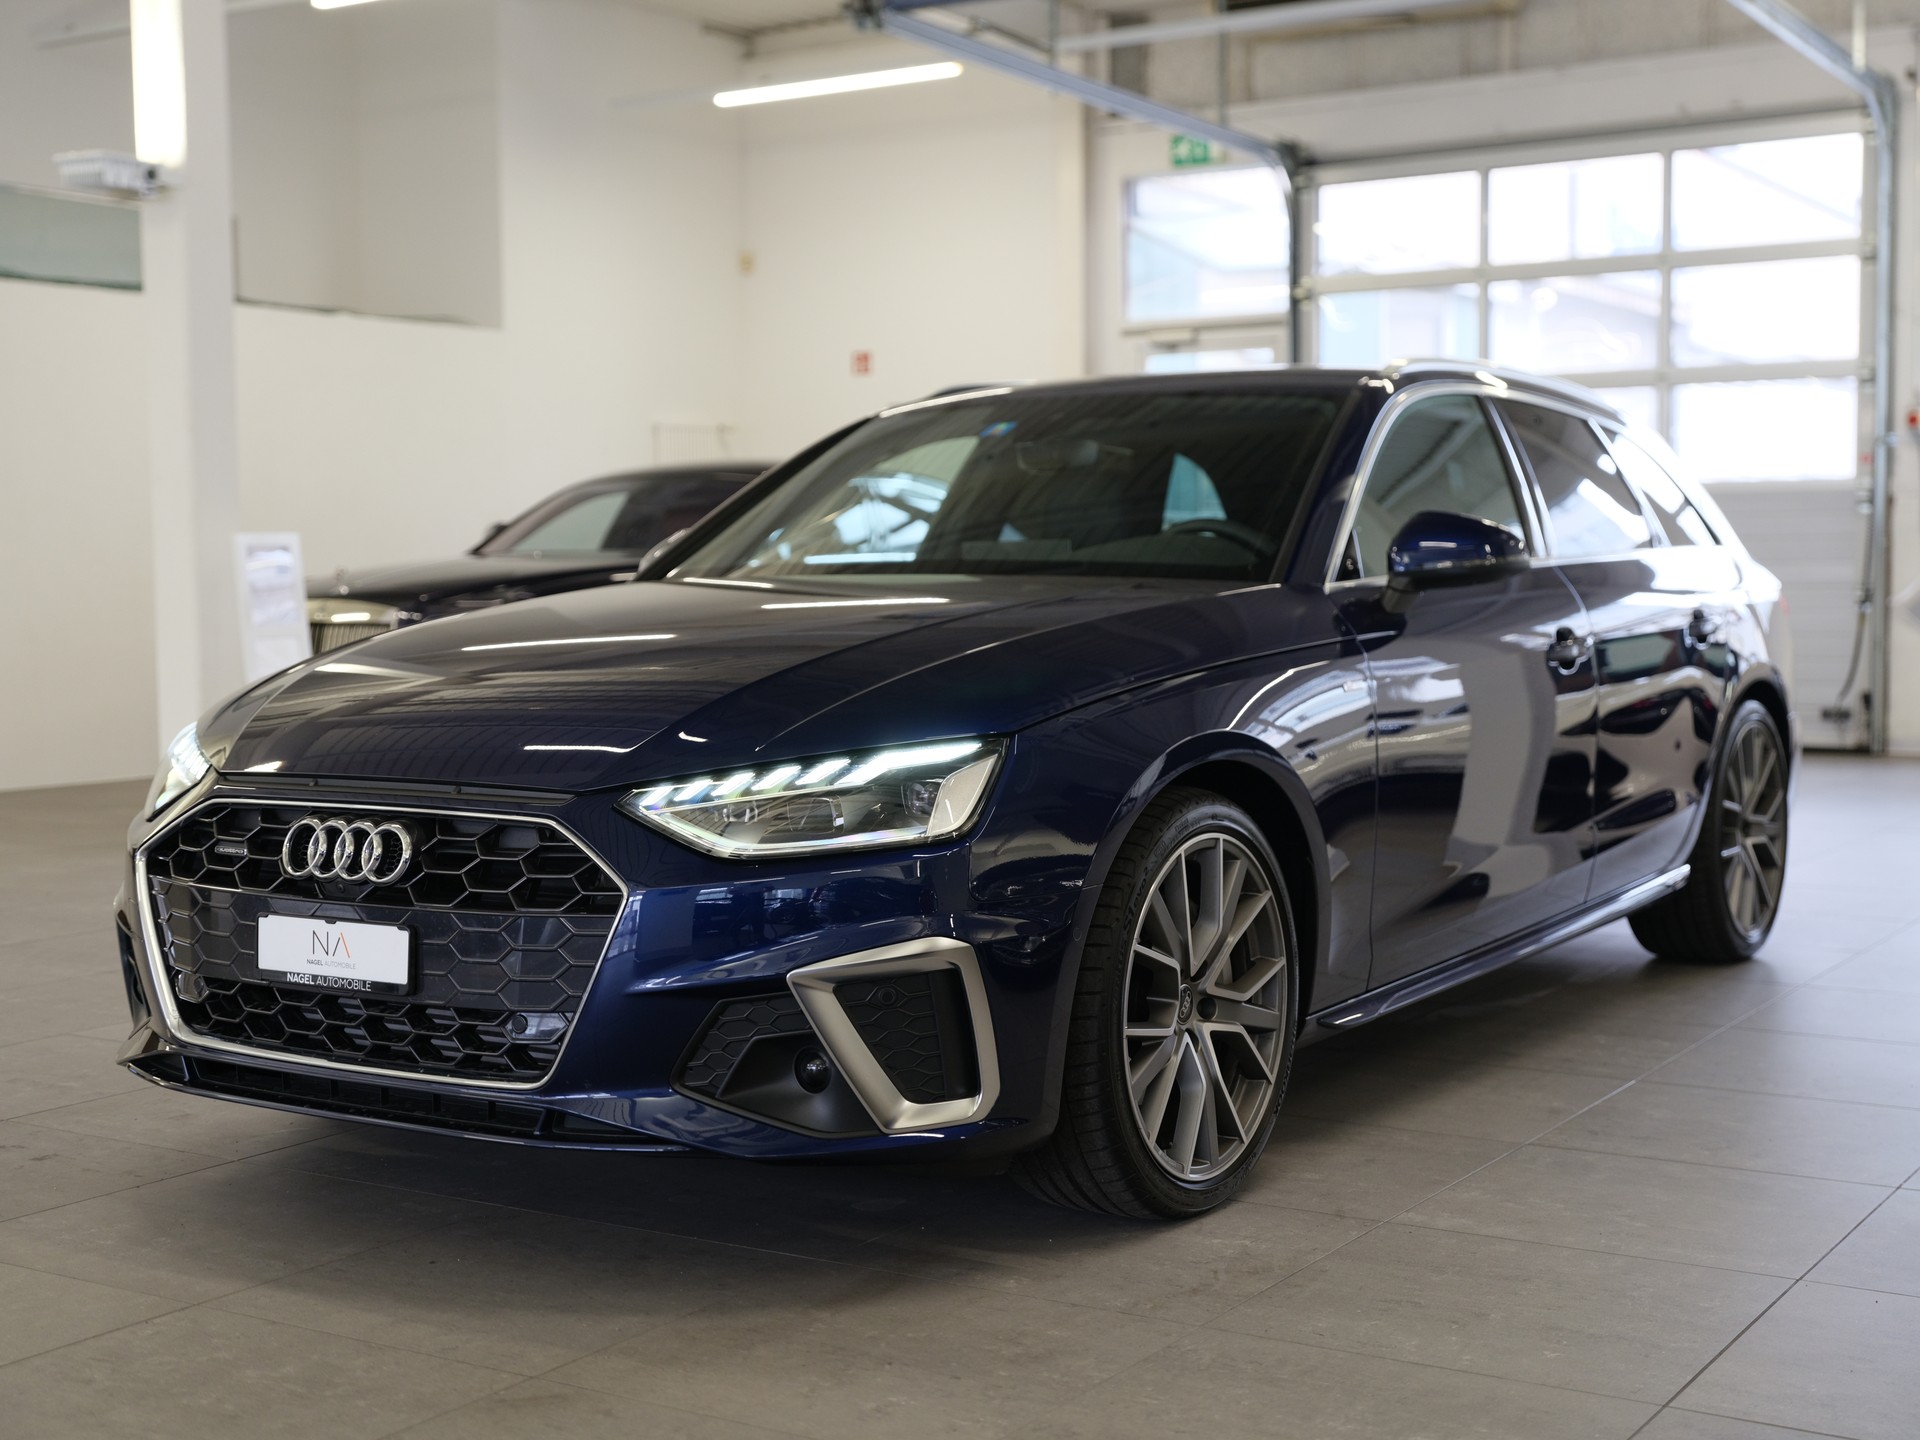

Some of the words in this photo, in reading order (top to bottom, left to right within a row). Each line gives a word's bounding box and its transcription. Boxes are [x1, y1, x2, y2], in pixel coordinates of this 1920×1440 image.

[306, 958, 324, 967] NAGEL
[324, 961, 357, 970] AUTOMOBILE
[286, 972, 315, 985] NAGEL
[315, 975, 372, 992] AUTOMOBILE
